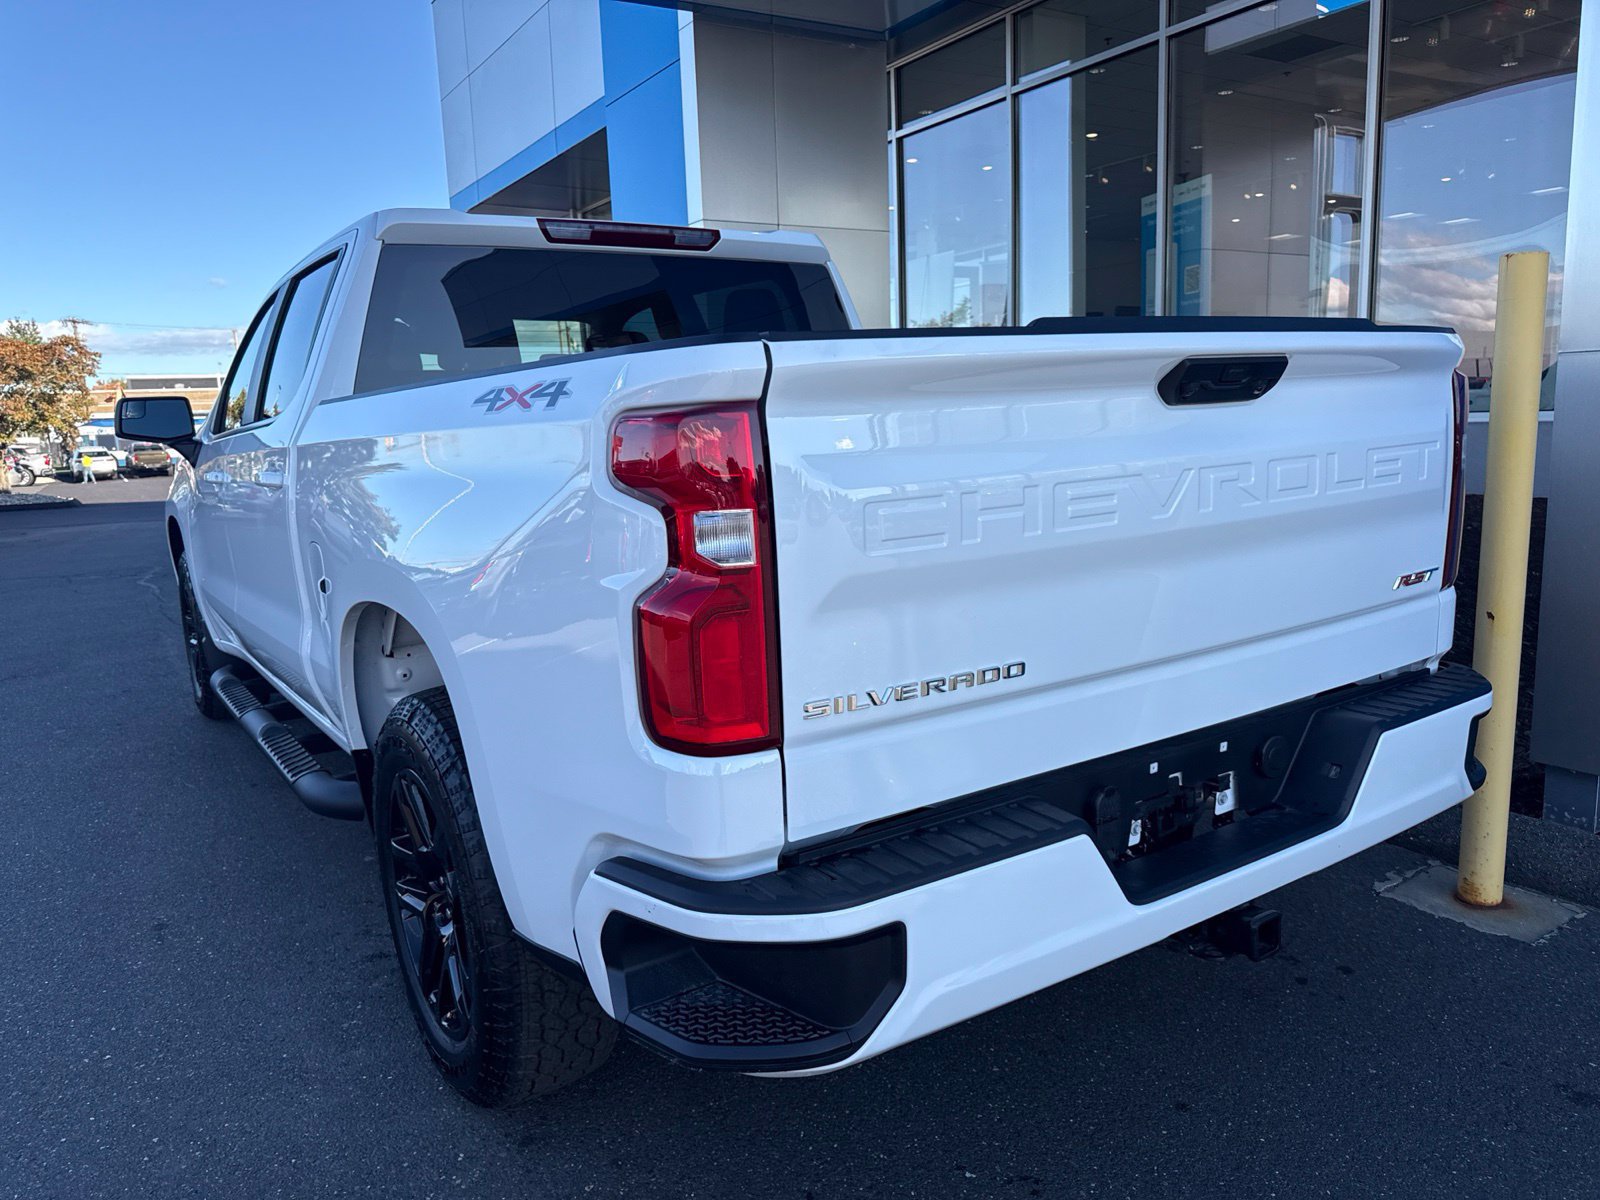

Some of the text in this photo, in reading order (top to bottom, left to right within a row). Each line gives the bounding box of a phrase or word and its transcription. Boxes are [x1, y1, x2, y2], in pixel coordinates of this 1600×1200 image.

[864, 441, 1440, 556] CHEVROLET
[1392, 567, 1439, 590] RST
[803, 661, 1026, 720] SILVERADO
